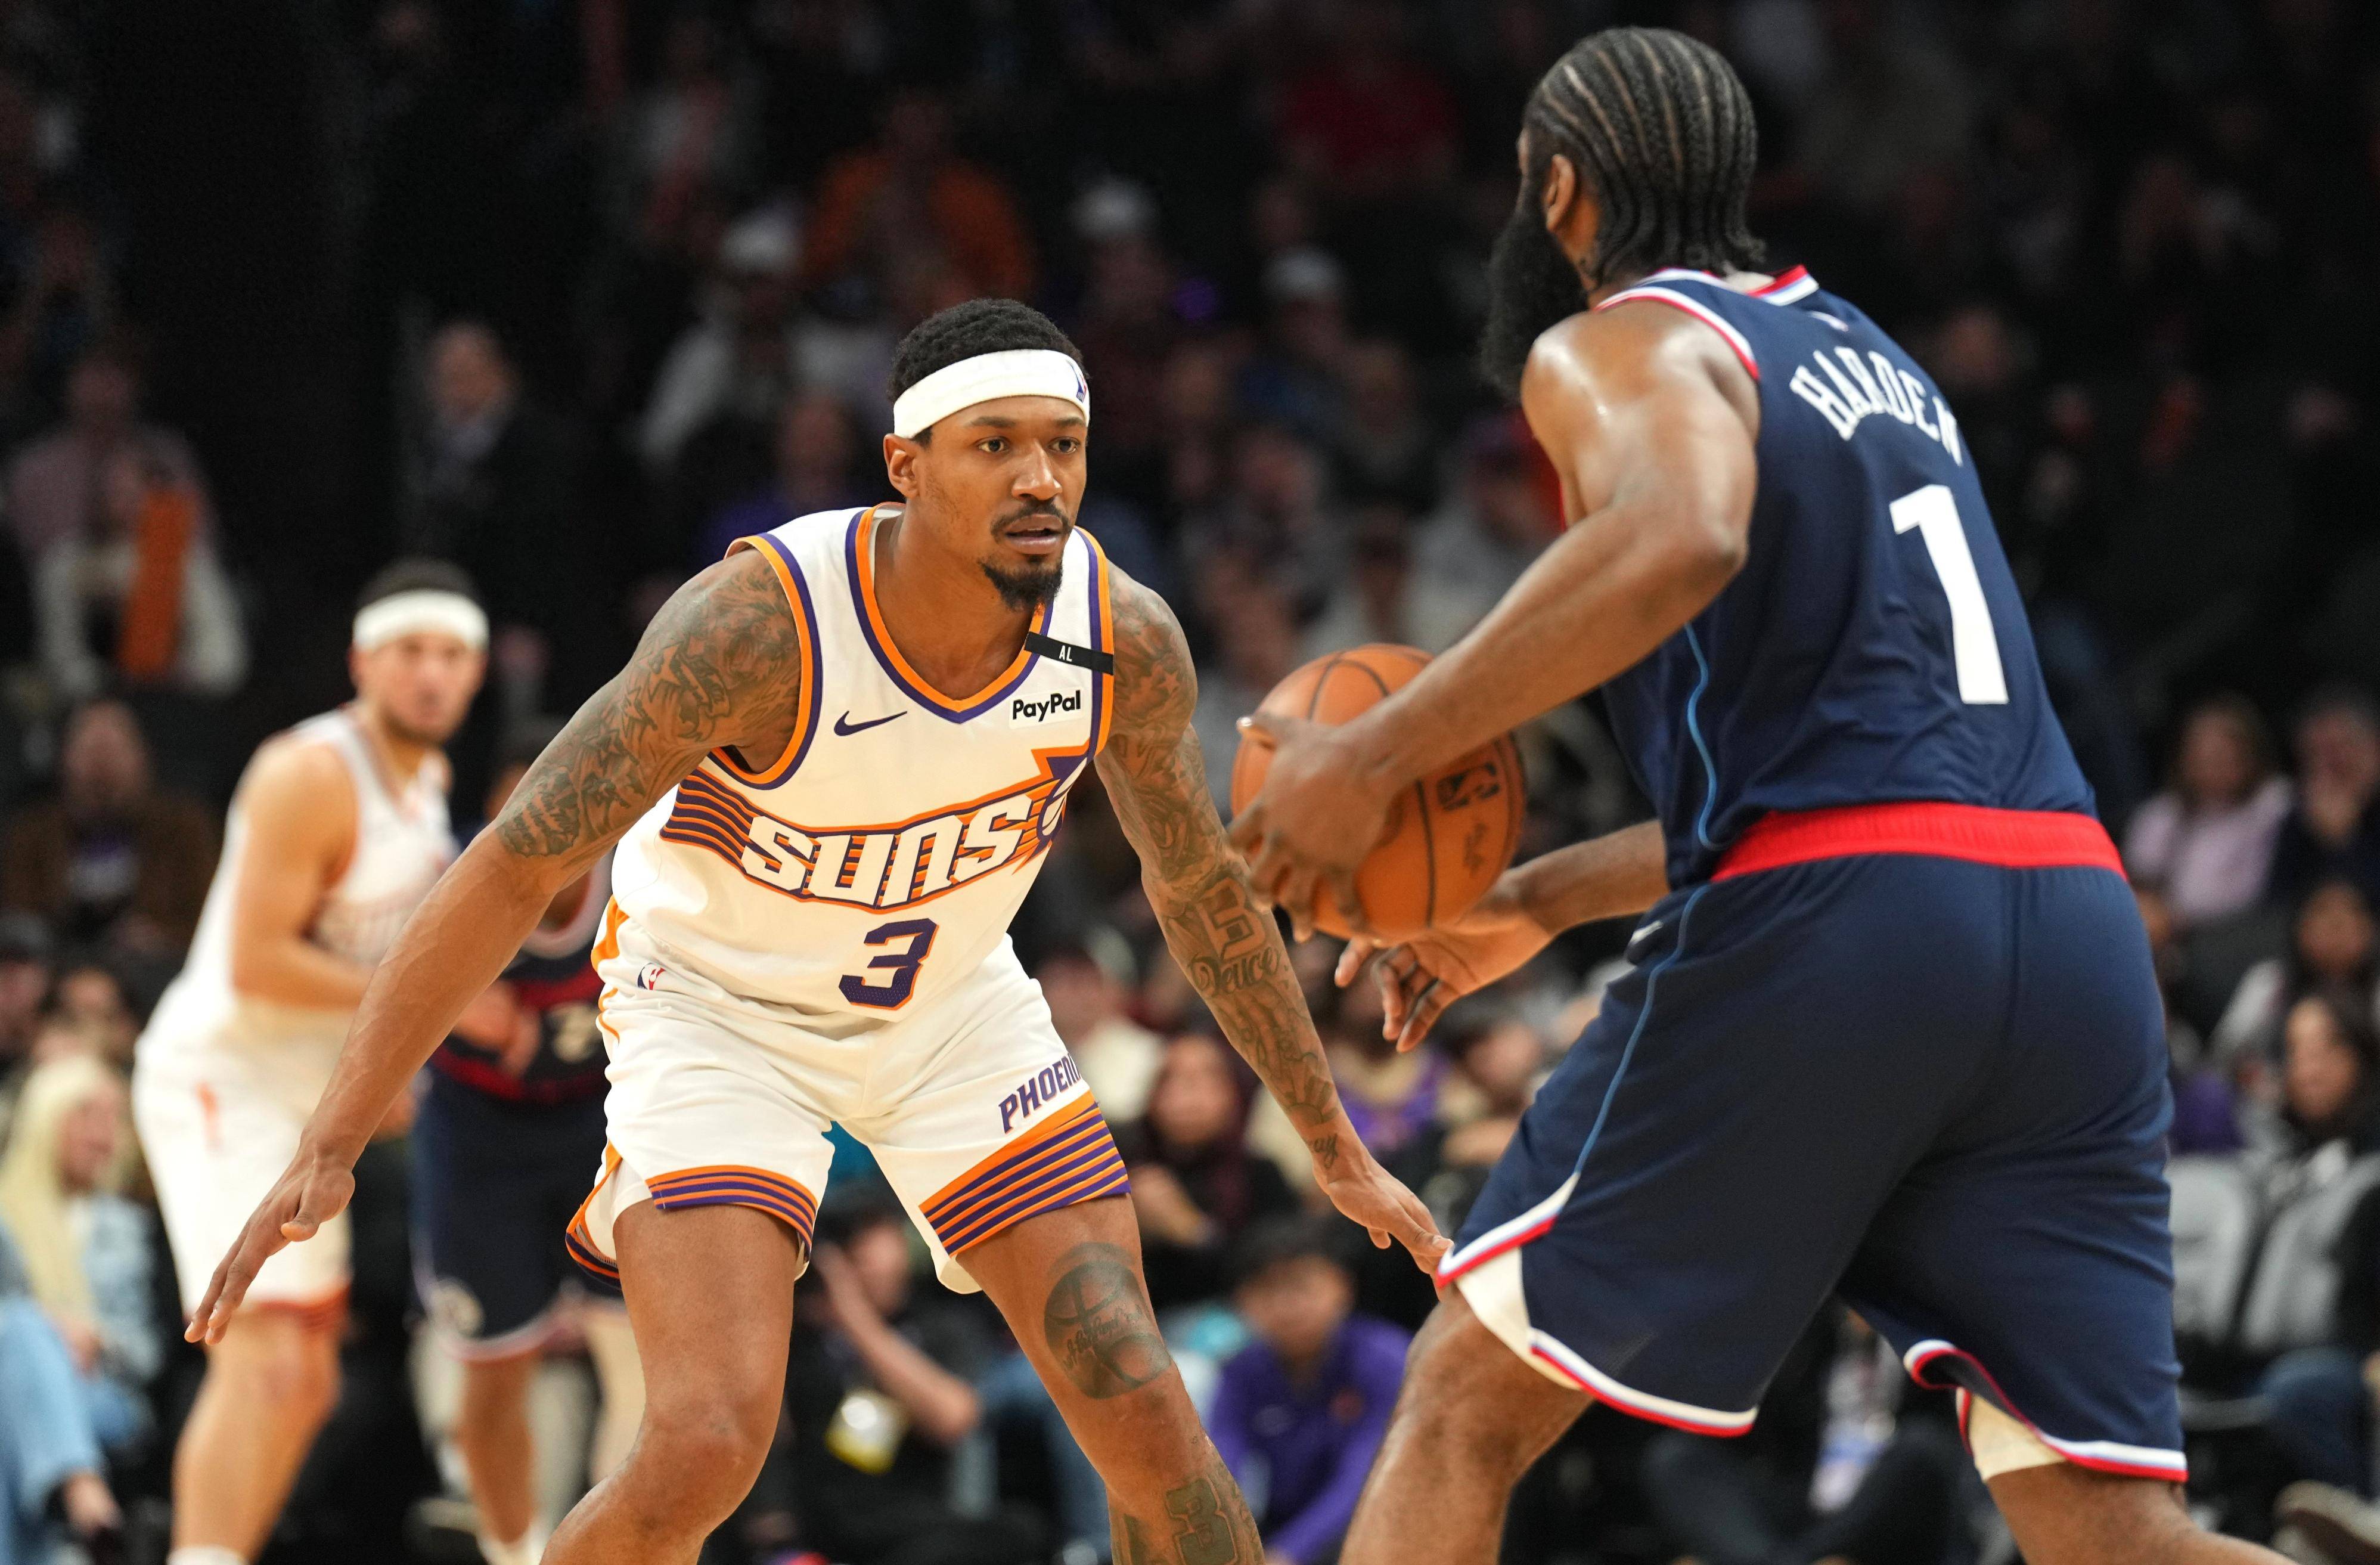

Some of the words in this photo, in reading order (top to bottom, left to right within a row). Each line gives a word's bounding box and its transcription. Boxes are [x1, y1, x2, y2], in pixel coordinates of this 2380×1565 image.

[1789, 346, 1963, 467] HARDEN
[1889, 484, 2009, 704] 1
[1059, 645, 1073, 662] AL
[1012, 689, 1081, 723] PayPal
[838, 918, 939, 1011] 3
[998, 1052, 1082, 1135] PHOENI
